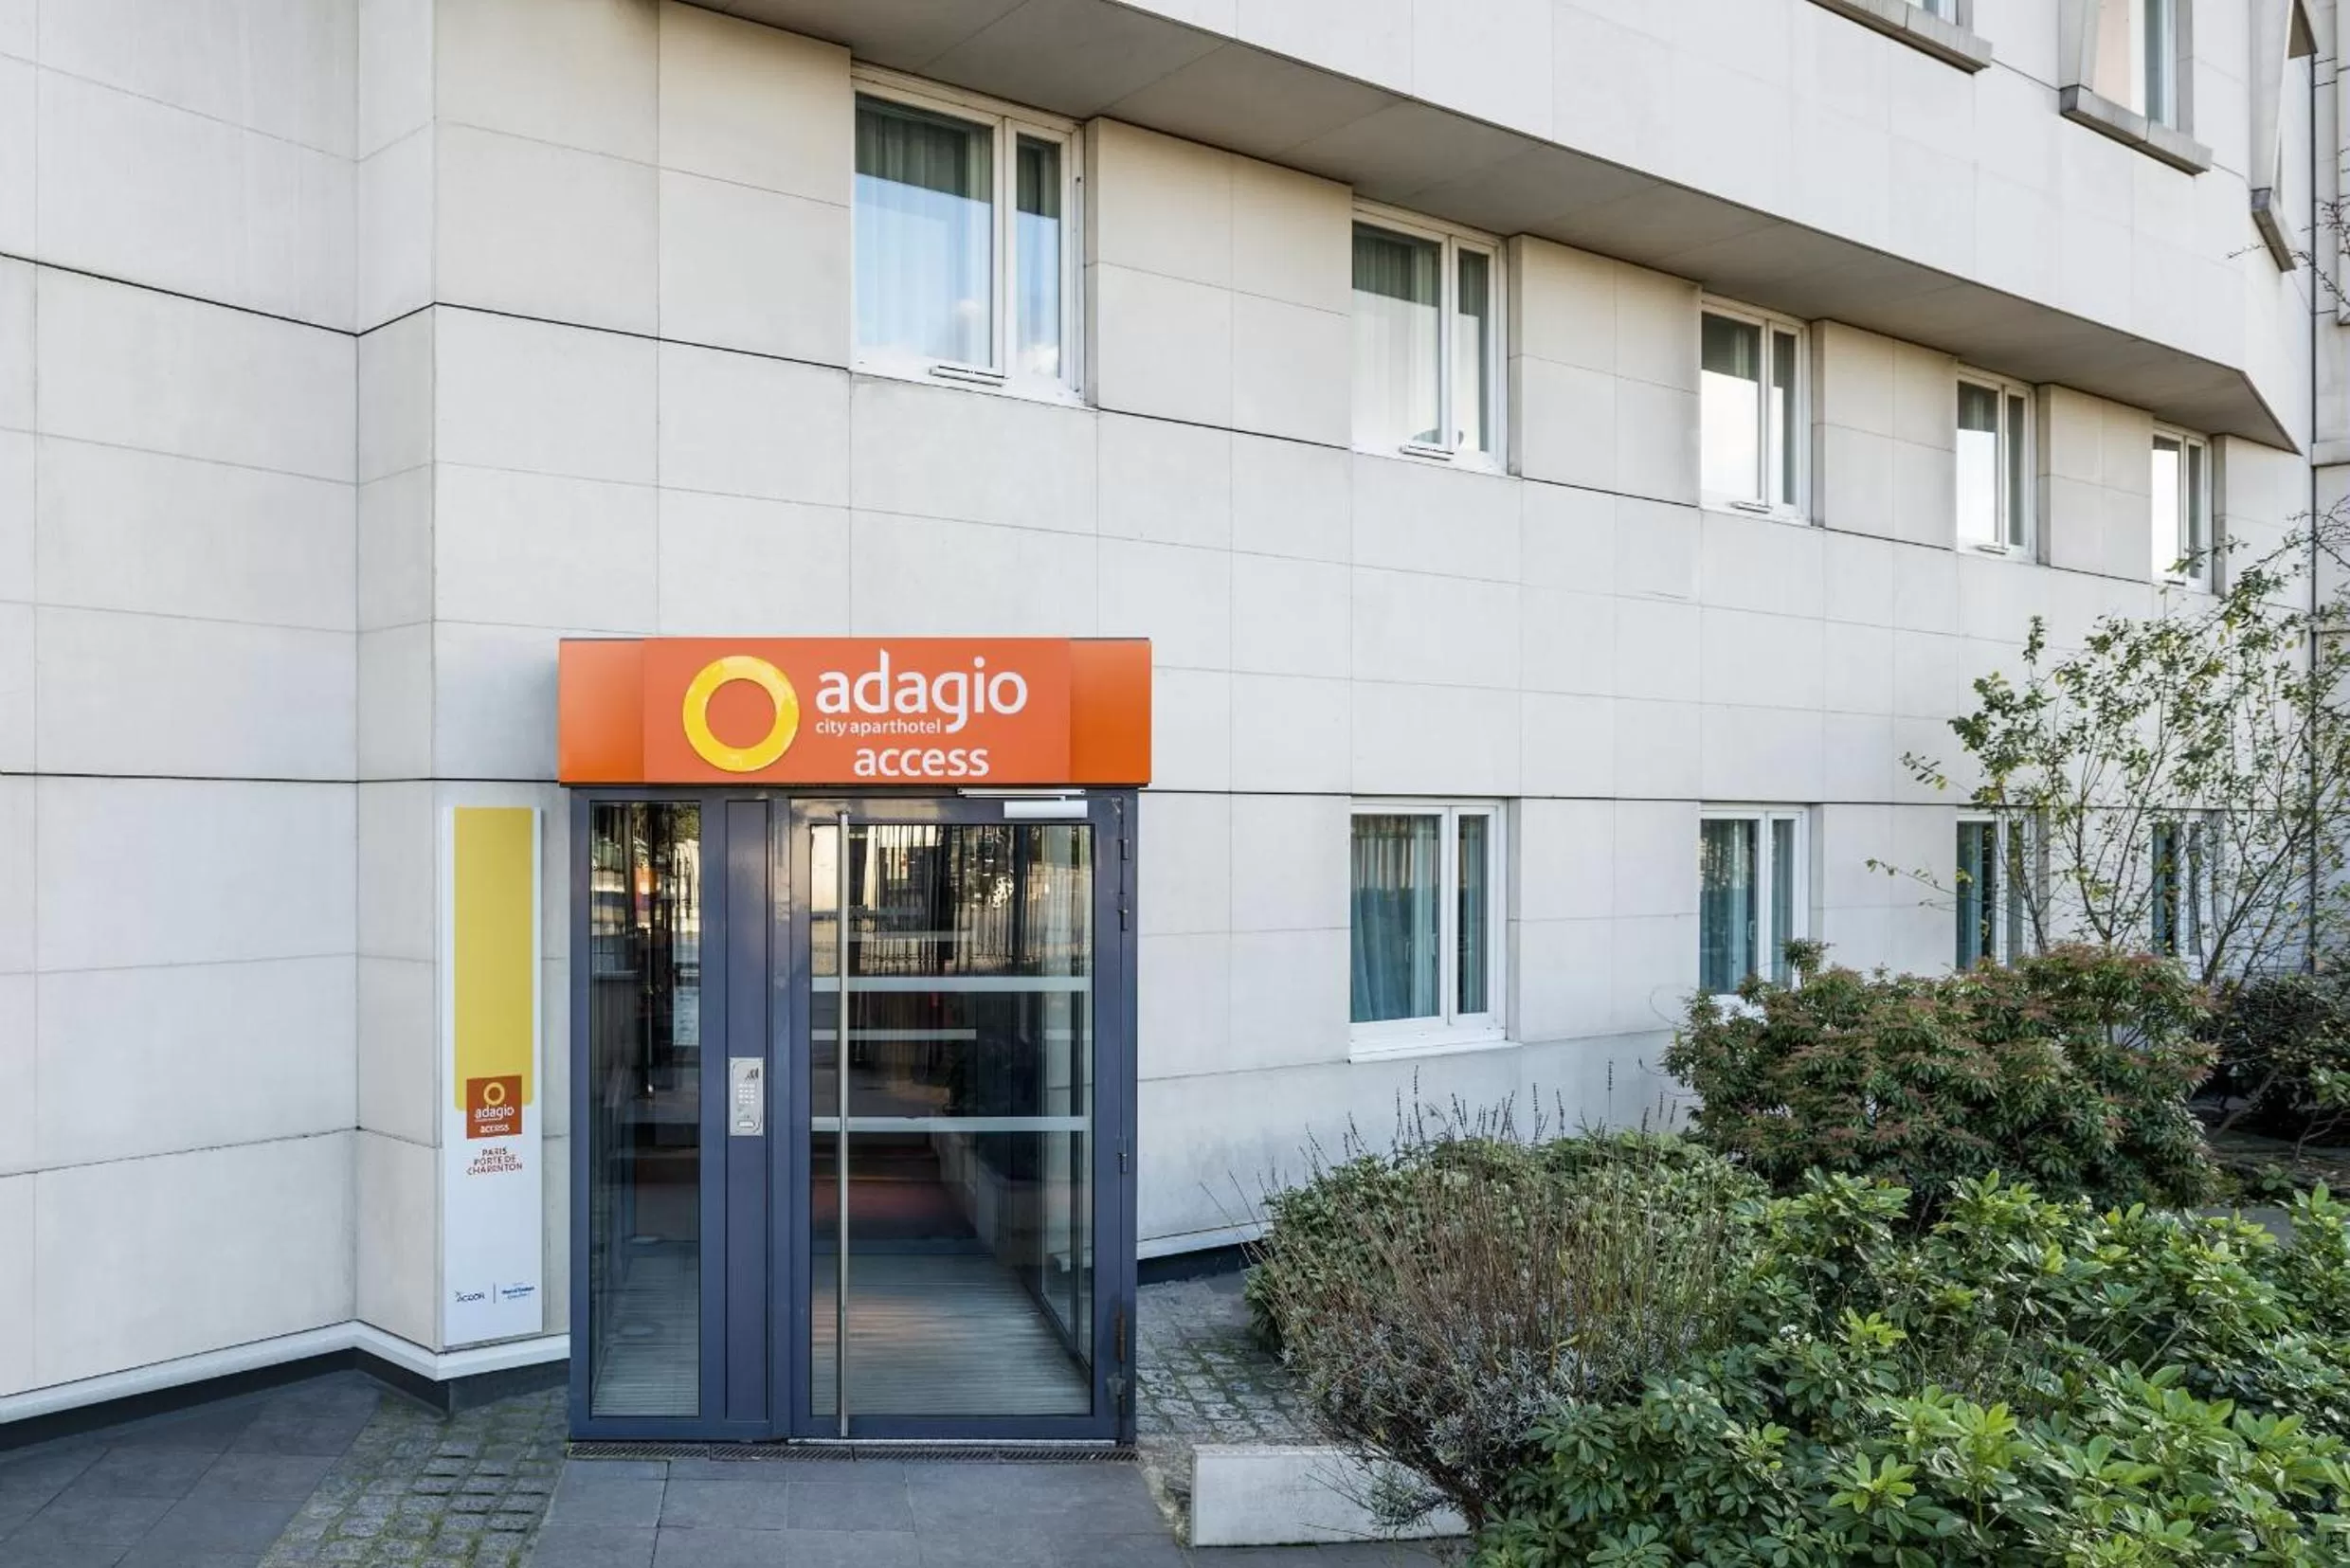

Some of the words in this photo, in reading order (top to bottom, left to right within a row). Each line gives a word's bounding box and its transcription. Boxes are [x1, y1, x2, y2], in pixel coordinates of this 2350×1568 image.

[815, 648, 1028, 733] adagio
[815, 718, 846, 736] city
[849, 717, 941, 736] aparthotel
[854, 747, 990, 777] access
[475, 1104, 515, 1120] adagio
[481, 1147, 508, 1156] PARIS
[474, 1156, 502, 1166] PORTE
[504, 1154, 516, 1163] DE
[466, 1163, 523, 1176] CHARENTON
